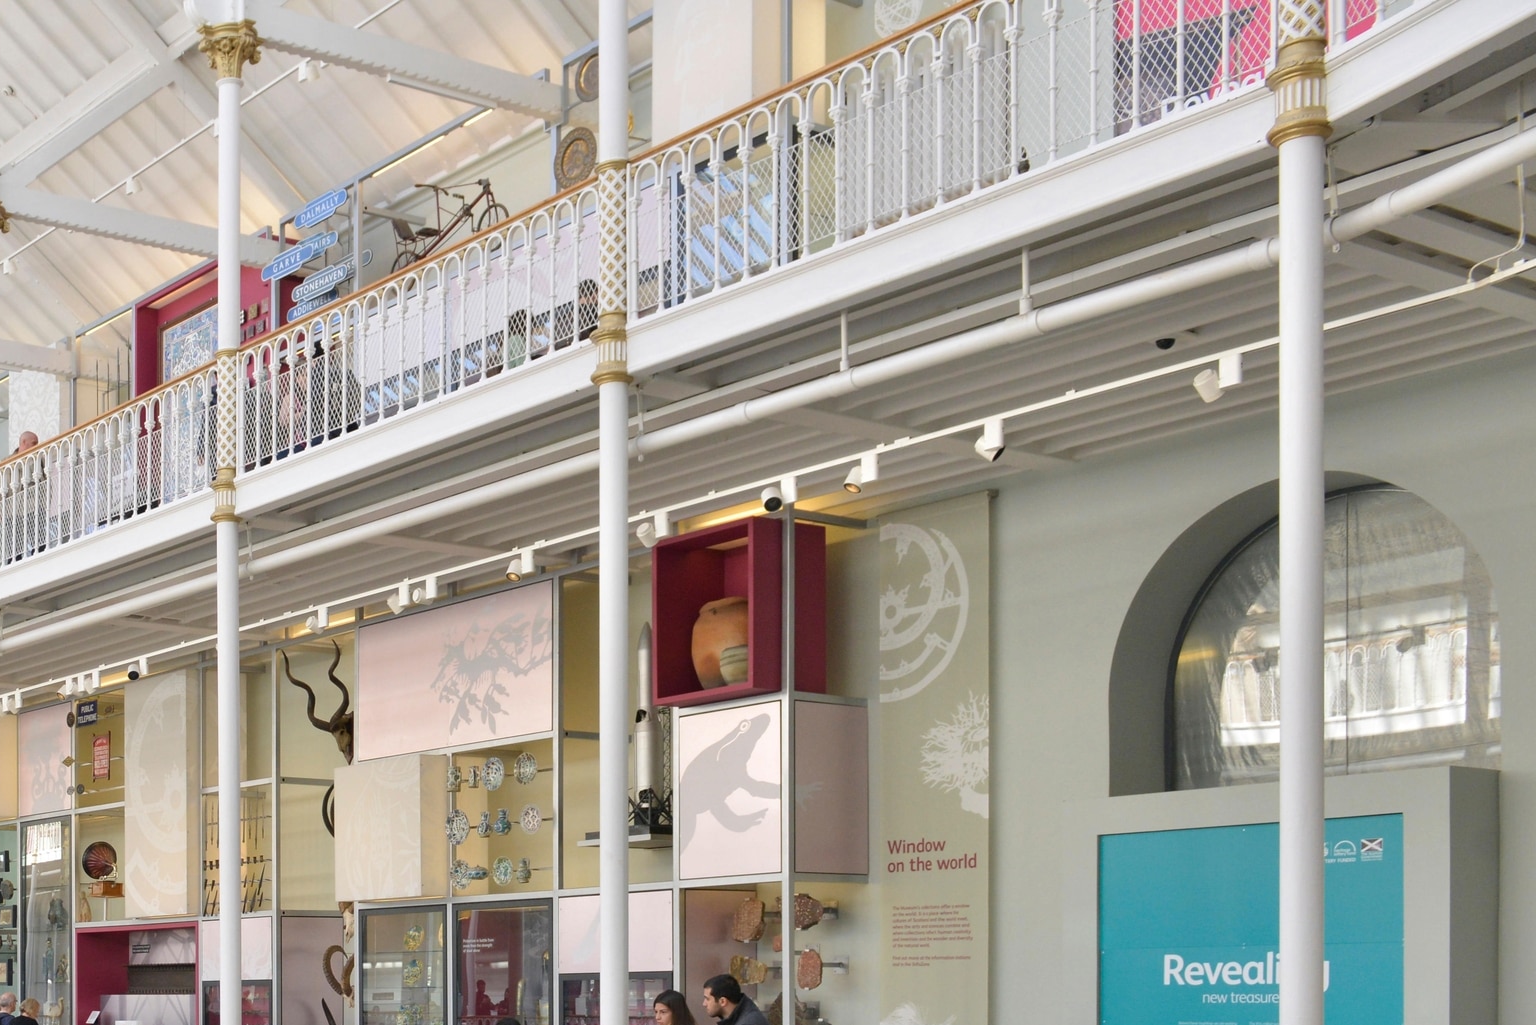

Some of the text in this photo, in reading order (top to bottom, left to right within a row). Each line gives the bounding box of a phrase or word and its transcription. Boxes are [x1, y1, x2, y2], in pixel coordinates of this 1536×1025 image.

[301, 195, 340, 223] DALMALLY
[313, 236, 331, 251] AIRS
[273, 251, 301, 273] GARVE
[295, 267, 344, 298] STONEHAVEN
[292, 292, 332, 318] ADDIEWELL
[80, 703, 94, 714] PUBLIC
[887, 837, 946, 854] Window
[887, 853, 977, 873] on the world
[1164, 952, 1330, 993] Reveali
[1202, 992, 1280, 1004] new treasure
